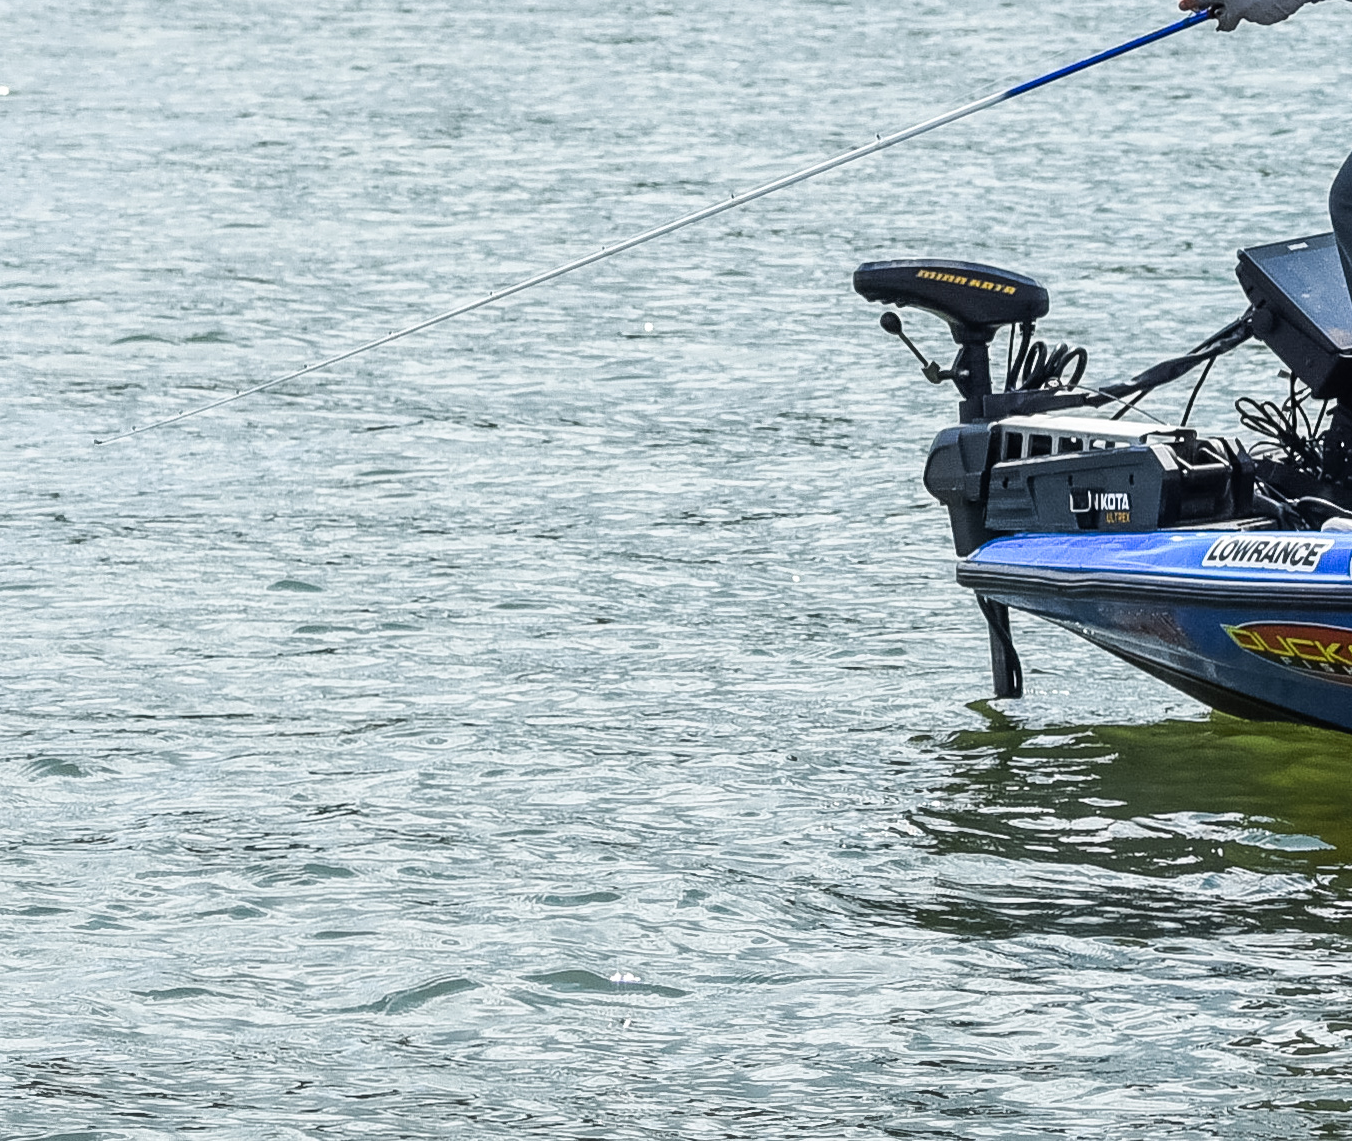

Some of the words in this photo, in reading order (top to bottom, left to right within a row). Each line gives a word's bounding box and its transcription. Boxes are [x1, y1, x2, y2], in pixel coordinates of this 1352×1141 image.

[915, 269, 968, 286] MINN
[969, 279, 1016, 295] KOTA
[1100, 493, 1130, 511] KOTA
[1206, 539, 1327, 567] LOWRANCE
